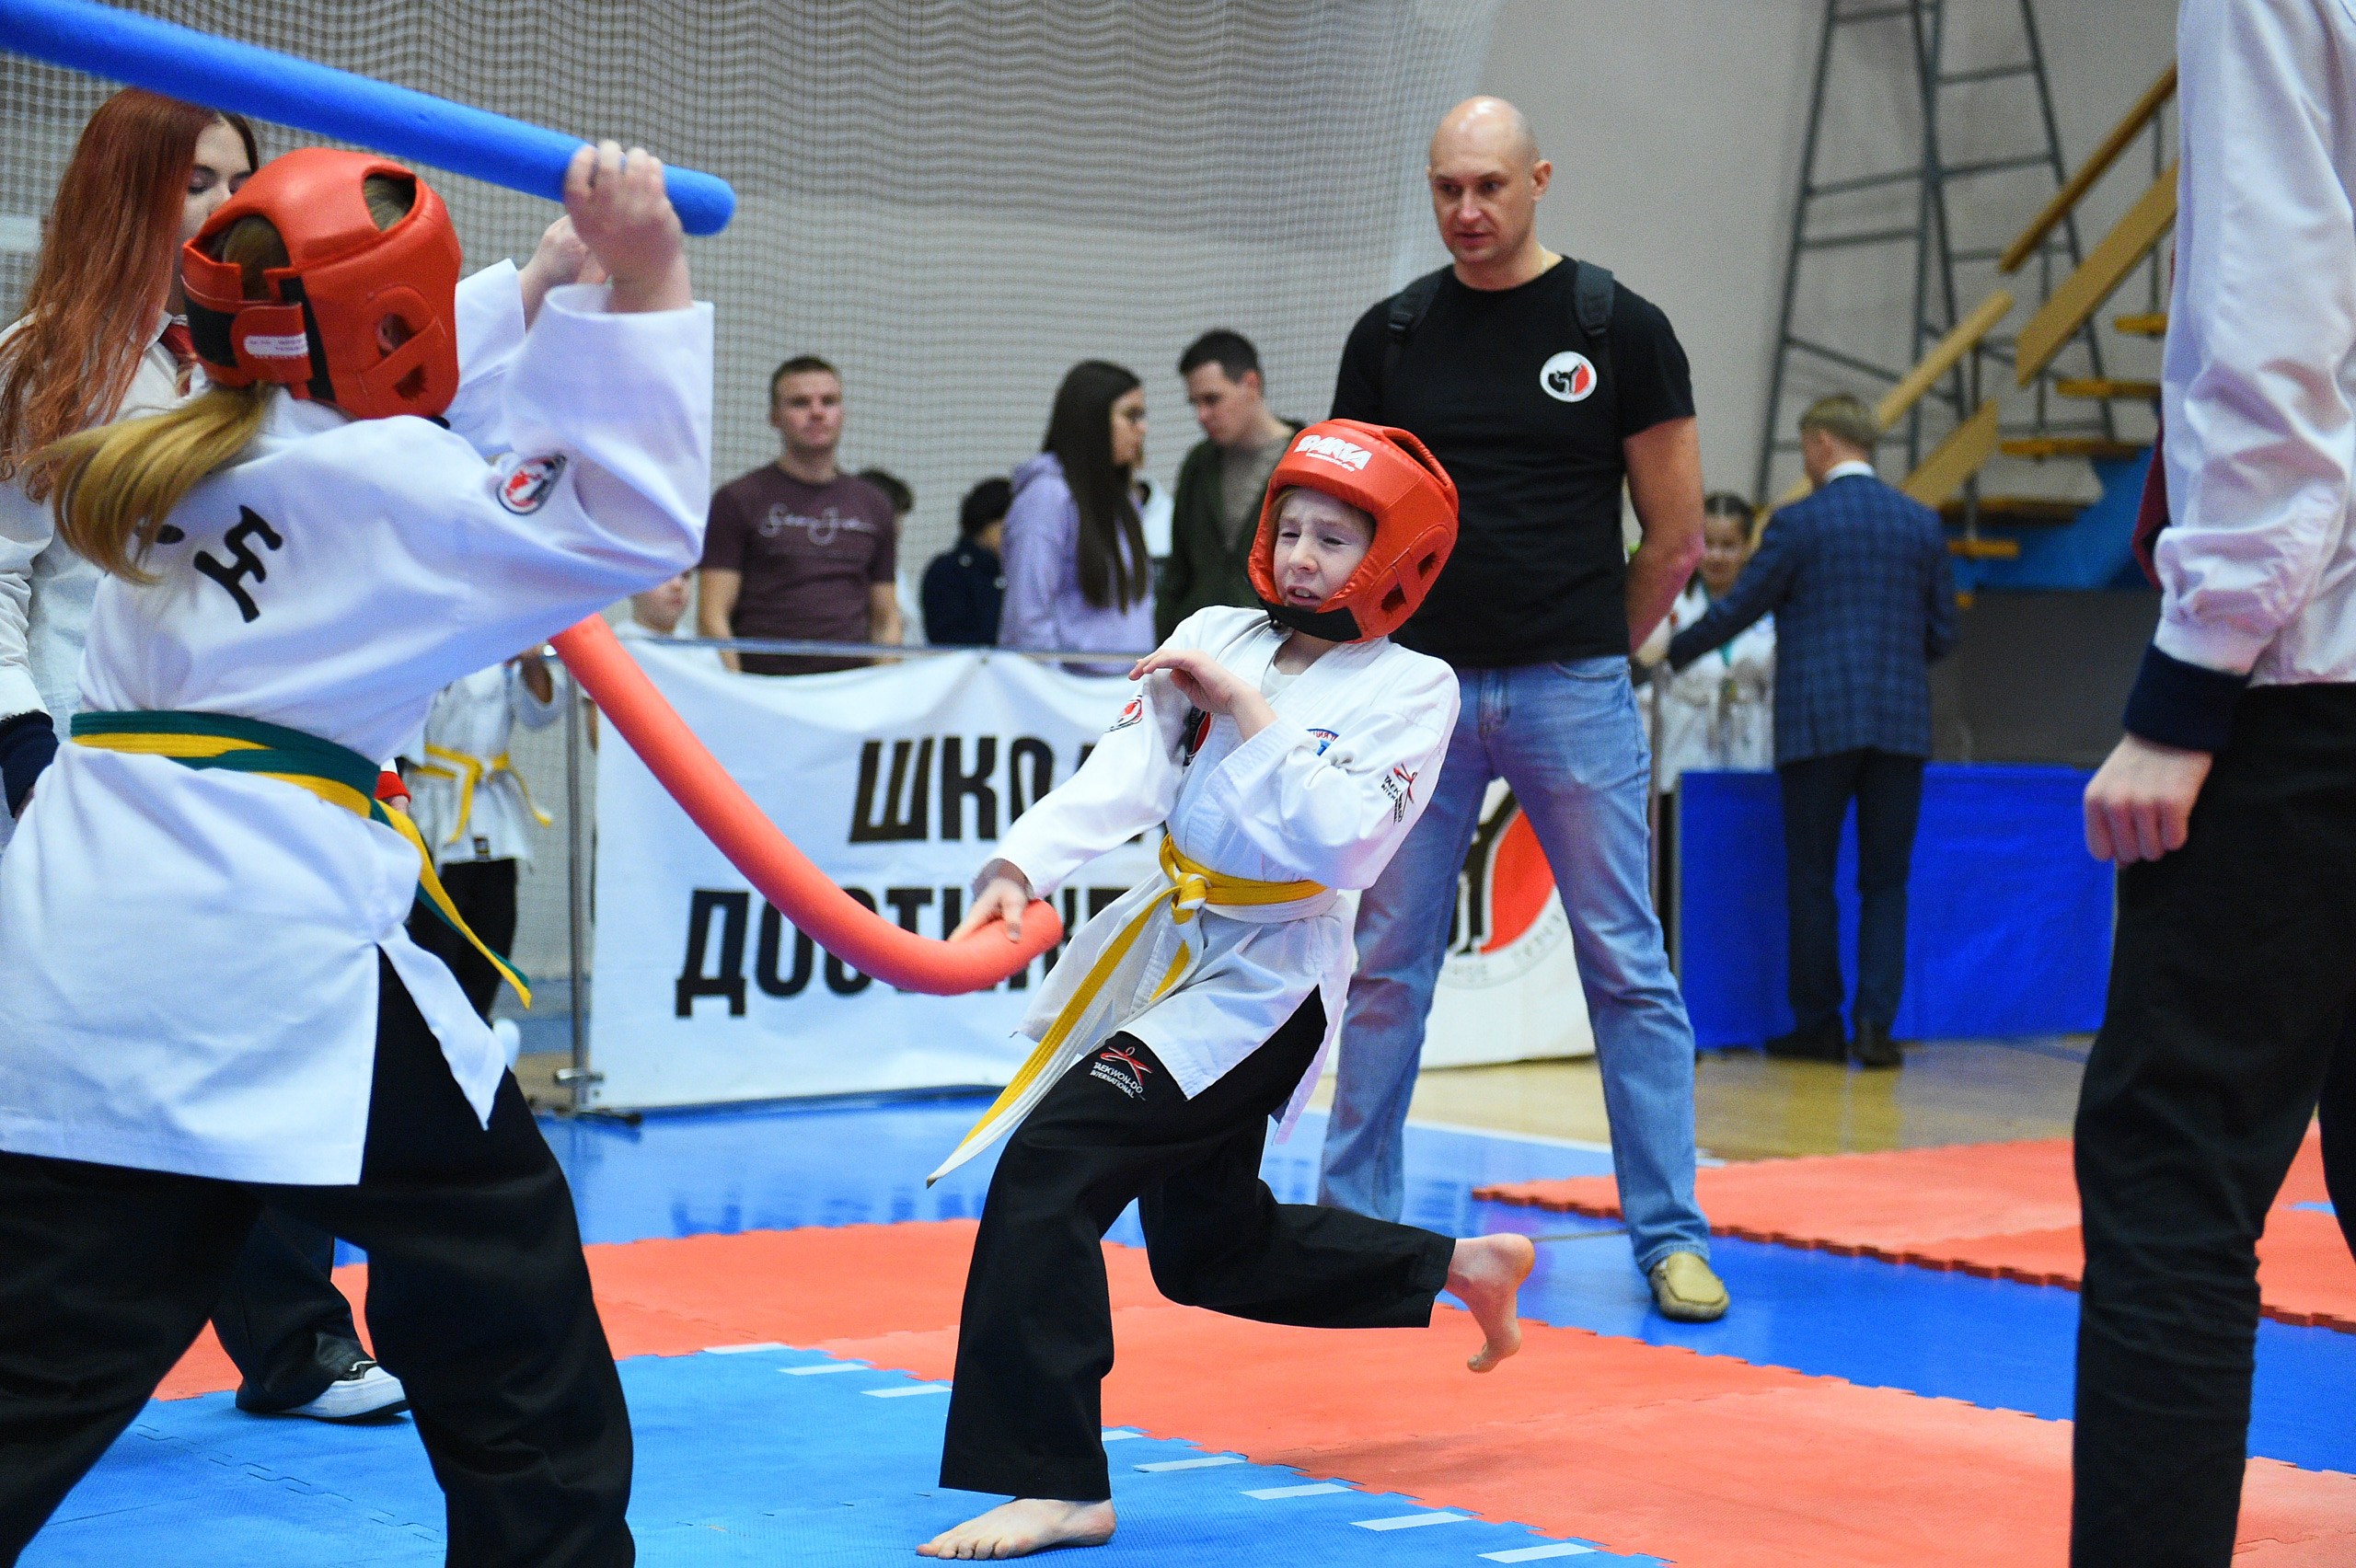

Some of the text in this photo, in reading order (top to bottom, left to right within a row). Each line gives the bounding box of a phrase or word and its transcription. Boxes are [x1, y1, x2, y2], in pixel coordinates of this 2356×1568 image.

[847, 735, 1168, 844] ШКО
[1090, 1069, 1135, 1099] INTERNATIONAL
[1092, 1061, 1143, 1094] TAEKWON-DO
